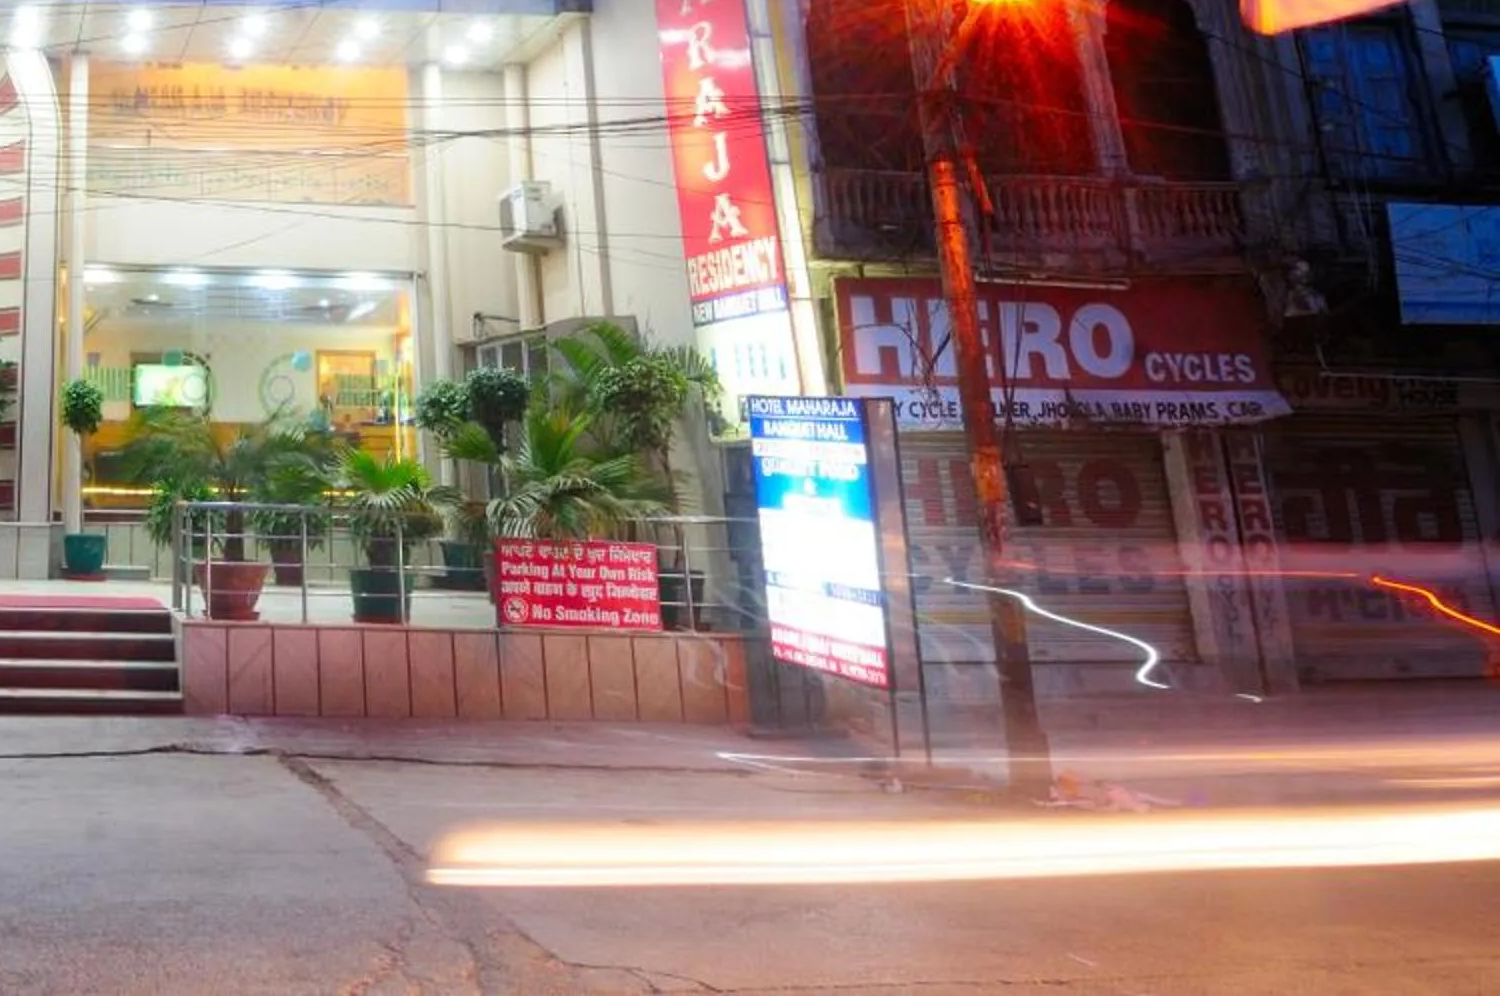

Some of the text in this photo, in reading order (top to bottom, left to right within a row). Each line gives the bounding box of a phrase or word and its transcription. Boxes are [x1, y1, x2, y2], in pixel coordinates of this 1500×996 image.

[687, 235, 777, 297] RESIDENCY
[1145, 352, 1256, 384] CYCLES
[751, 397, 857, 417] HOTEL MAHARAJA
[502, 562, 655, 582] Parking At Your Own Risk
[531, 604, 659, 625] No Smoking Zone
